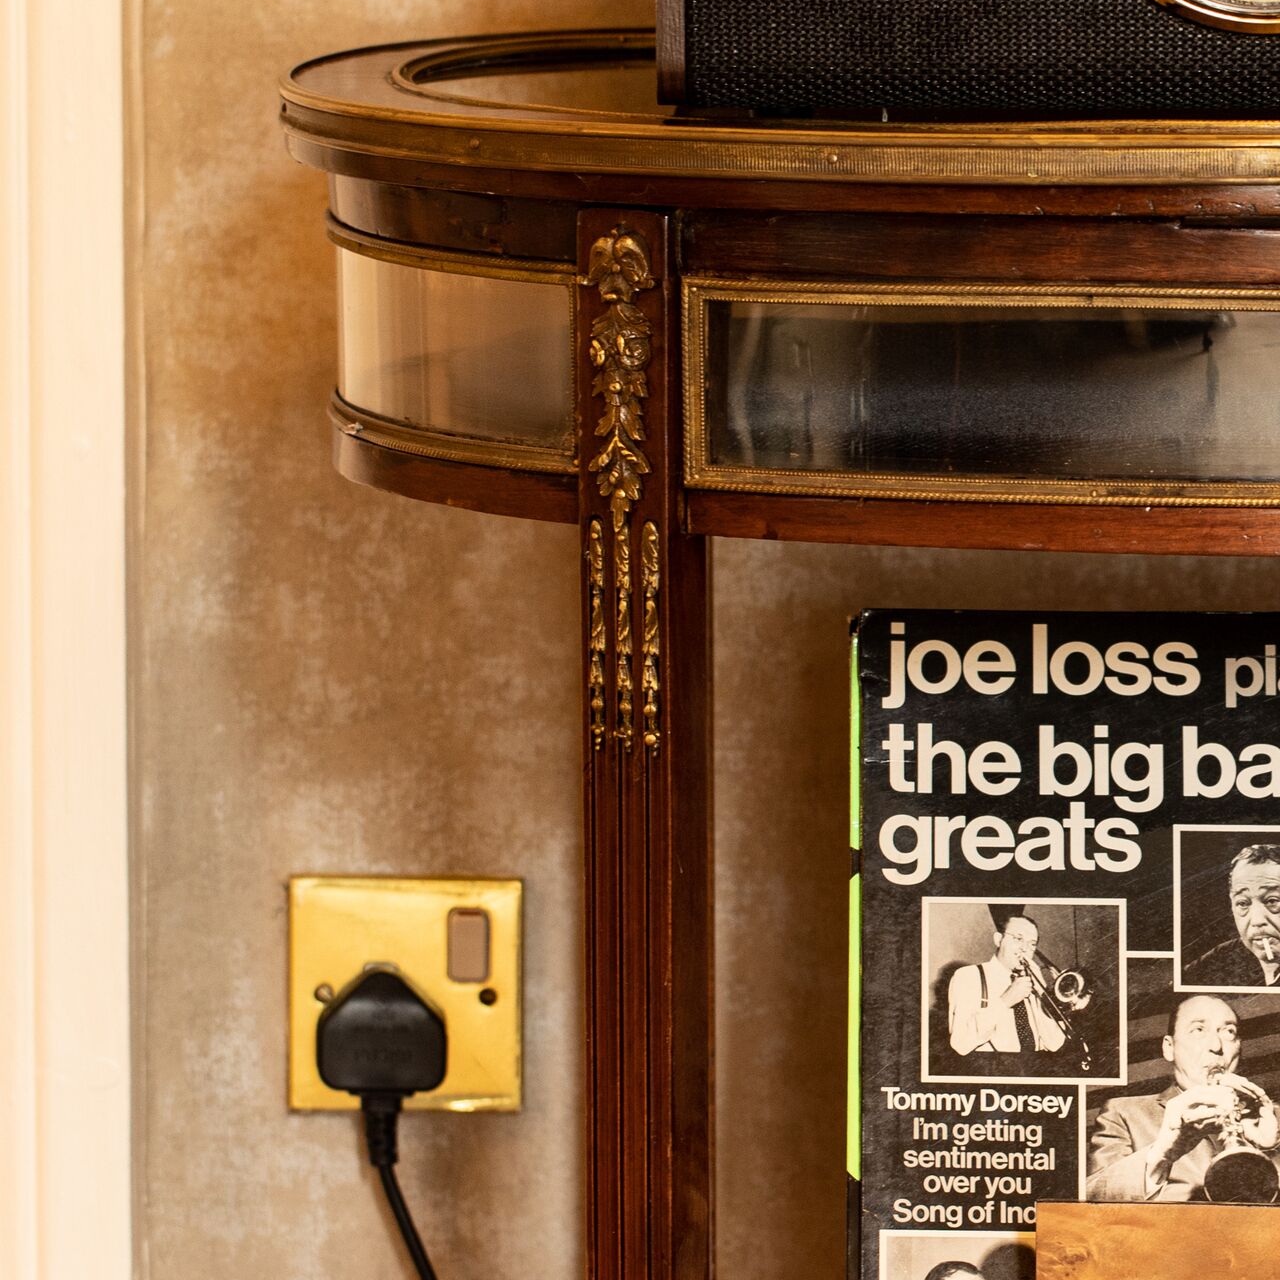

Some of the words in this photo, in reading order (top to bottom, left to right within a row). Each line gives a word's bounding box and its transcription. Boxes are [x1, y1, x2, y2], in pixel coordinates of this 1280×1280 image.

[881, 622, 1017, 709] joe
[1032, 624, 1201, 696] loss
[881, 723, 1022, 795] the
[1039, 725, 1164, 813] big
[879, 802, 1142, 886] greats
[880, 1086, 976, 1116] Tommy
[979, 1089, 1073, 1118] Dorsey
[913, 1117, 948, 1141] I'm
[952, 1120, 1043, 1147] getting
[903, 1146, 1056, 1170] sentimental
[923, 1174, 981, 1194] over
[984, 1177, 1032, 1199] you
[893, 1198, 963, 1228] Song
[967, 1201, 994, 1224] of
[1000, 1201, 1037, 1225] Ind
